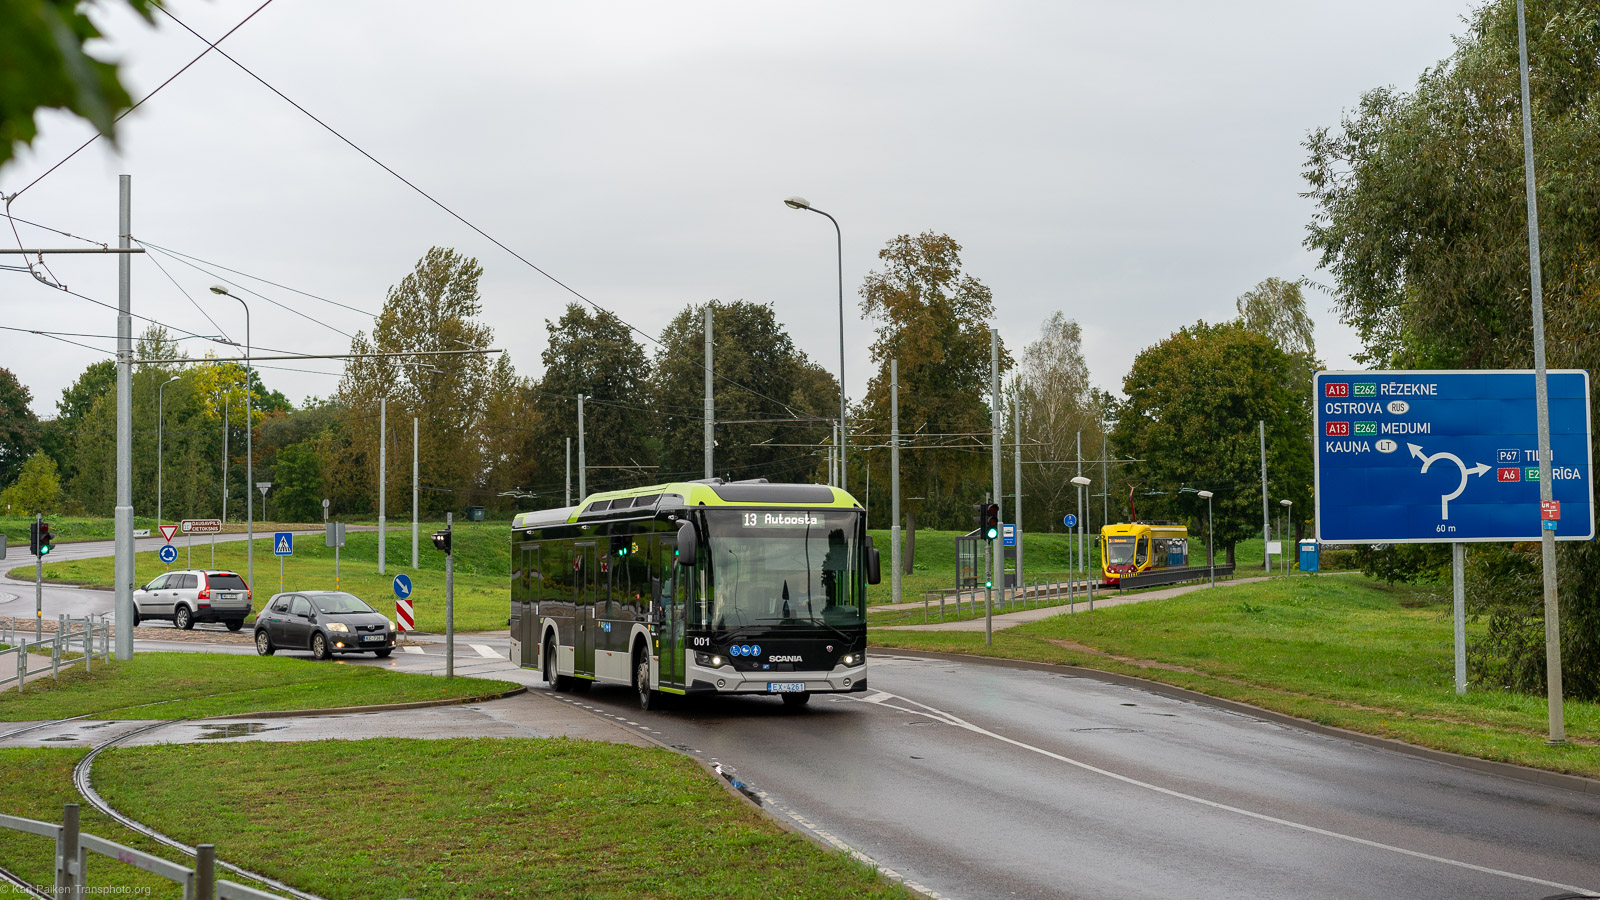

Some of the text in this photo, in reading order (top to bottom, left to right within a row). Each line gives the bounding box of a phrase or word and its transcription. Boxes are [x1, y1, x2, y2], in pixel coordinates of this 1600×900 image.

[1328, 382, 1438, 396] A13 E262 RĒZEKNE
[1325, 402, 1405, 415] OSTROVA RUS
[1328, 422, 1431, 434] A13 E262 MEDUMI
[1326, 441, 1392, 455] KAUŅA LT
[1500, 449, 1554, 462] P67 TILI
[1502, 468, 1581, 480] A6 E2 RĪGA
[744, 513, 818, 526] 13 Autoosta
[1436, 524, 1446, 533] 60
[694, 637, 710, 646] 001
[768, 654, 803, 663] SCANIA
